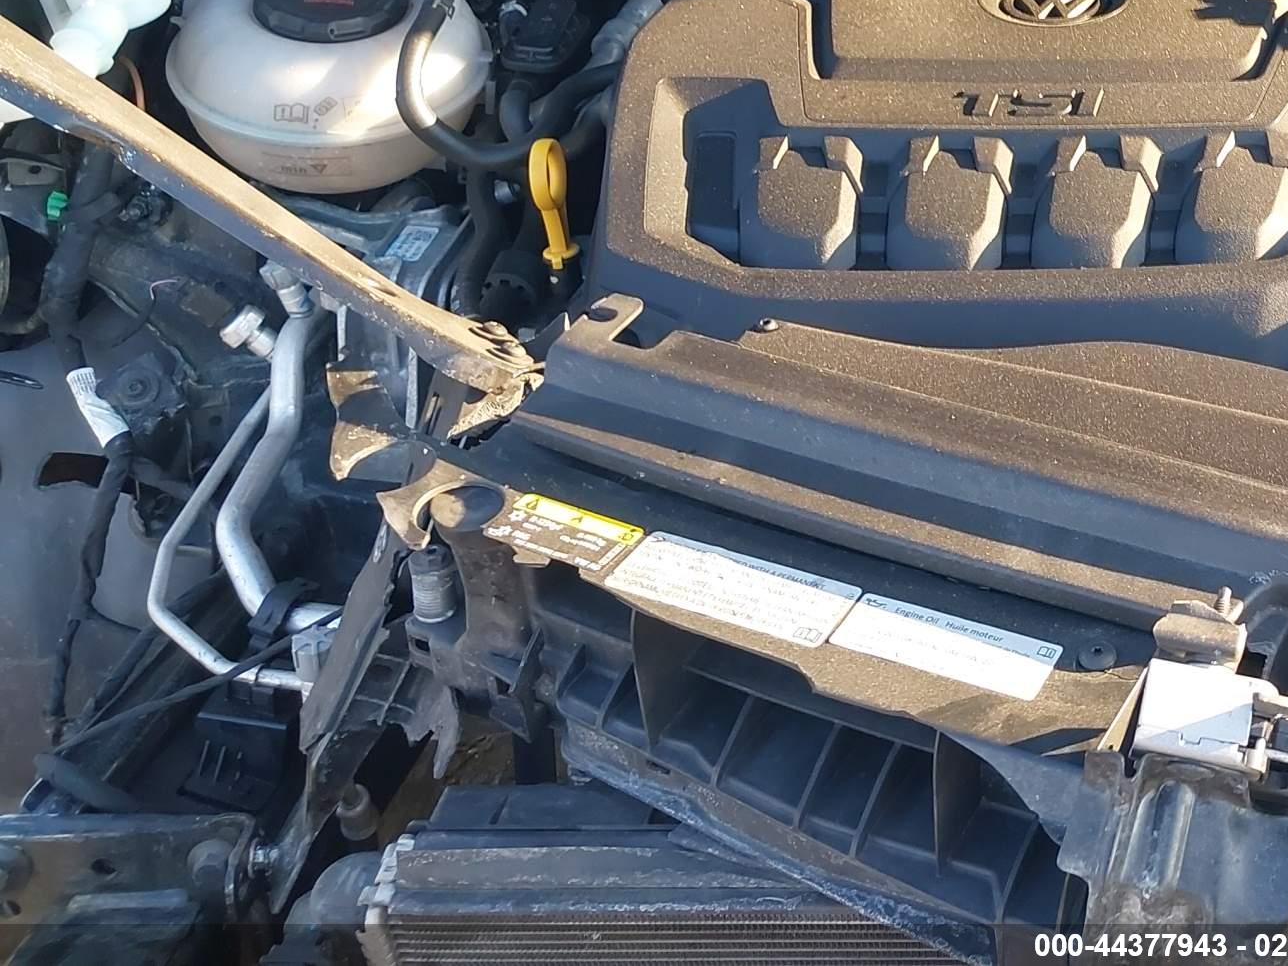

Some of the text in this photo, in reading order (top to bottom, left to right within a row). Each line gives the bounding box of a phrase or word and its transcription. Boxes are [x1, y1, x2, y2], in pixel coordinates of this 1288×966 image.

[953, 89, 1104, 117] TSI
[894, 606, 1005, 643] Engine Oil Huile moteur
